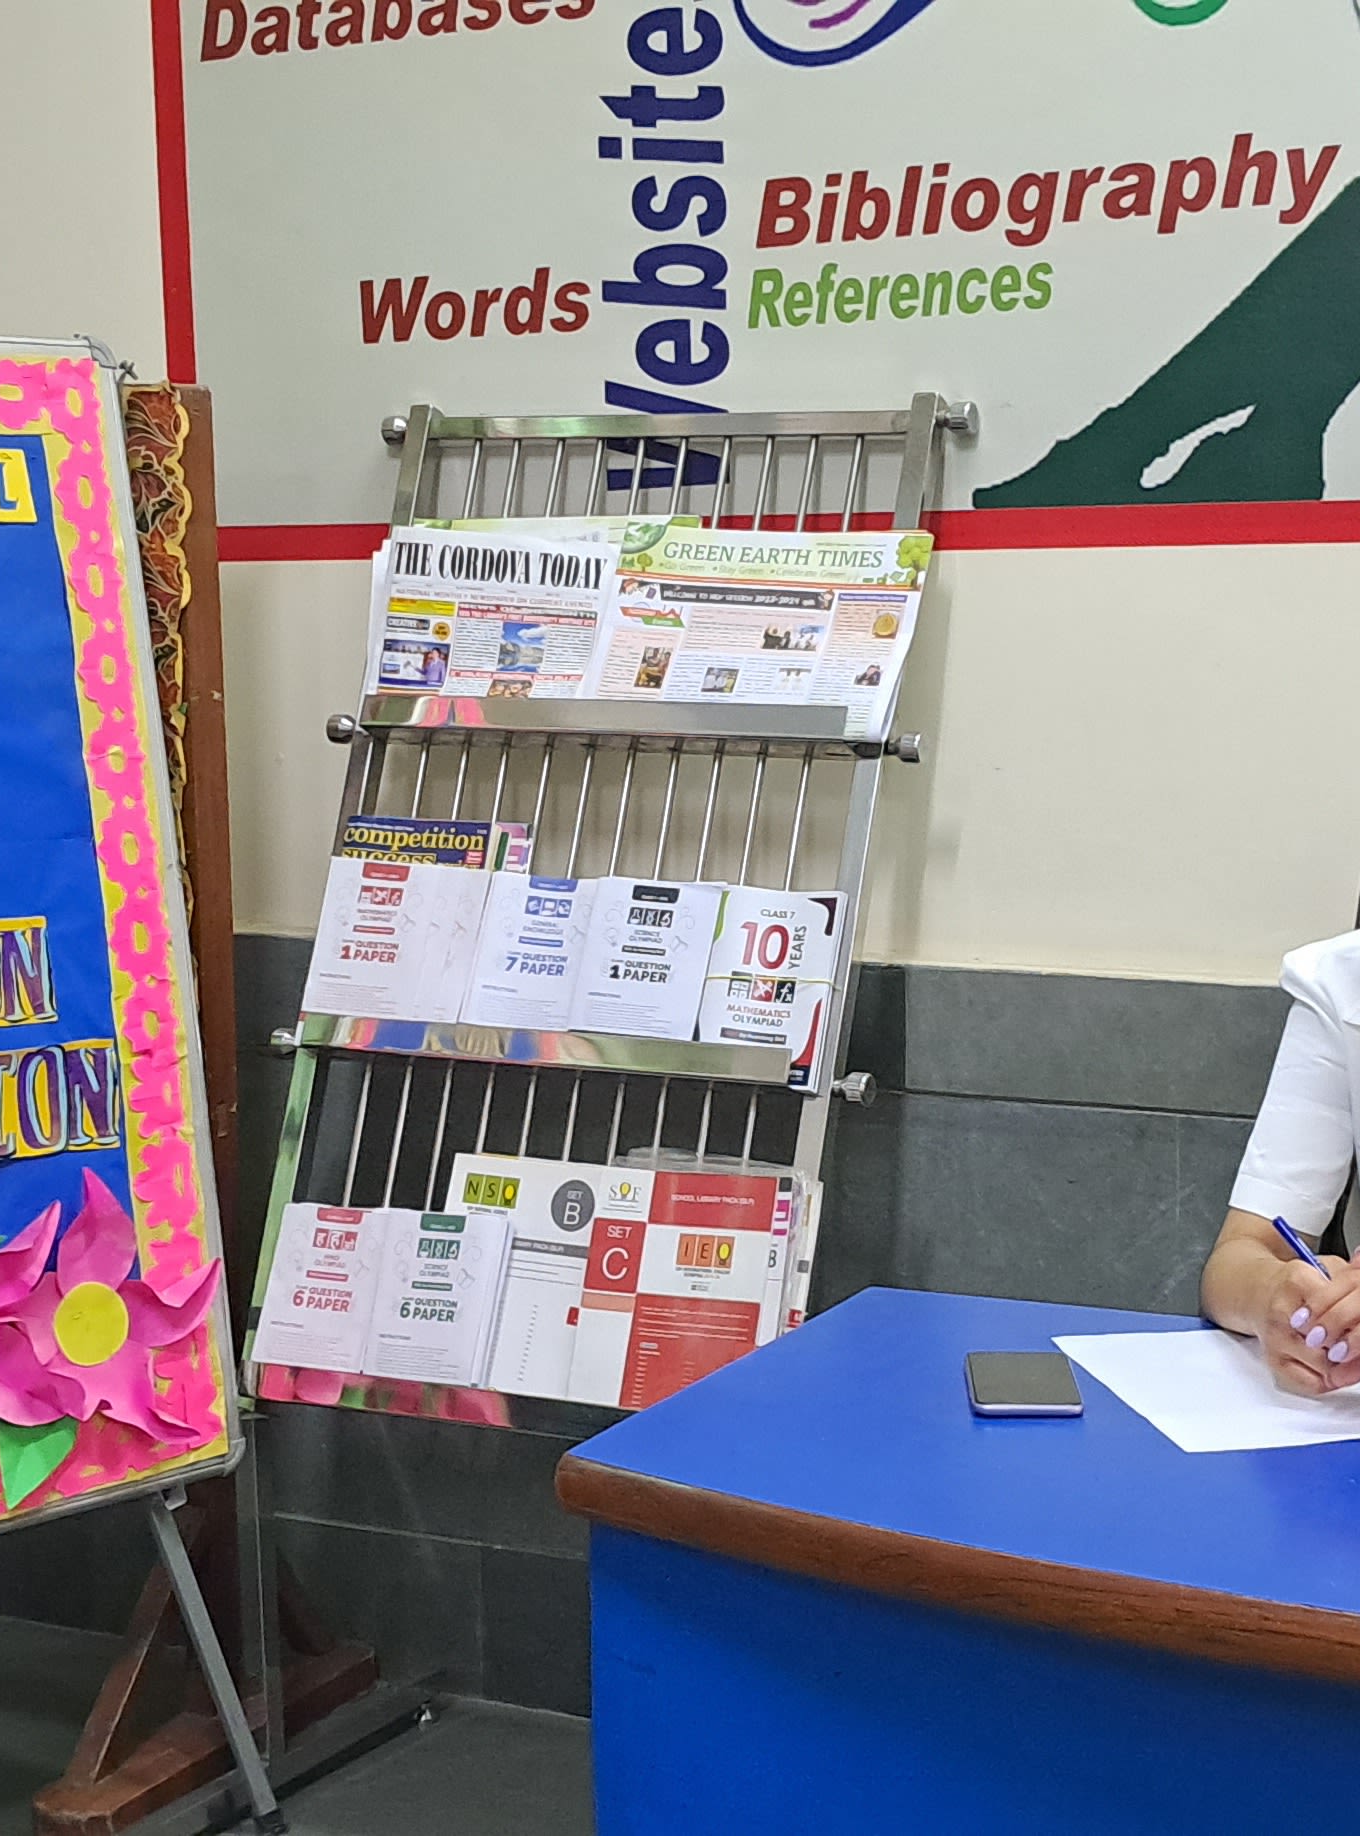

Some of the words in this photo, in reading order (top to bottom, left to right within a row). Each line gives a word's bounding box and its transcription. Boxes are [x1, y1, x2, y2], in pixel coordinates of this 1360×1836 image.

[755, 133, 1342, 249] Bibliography
[748, 258, 1053, 330] References
[359, 267, 591, 344] Words
[663, 541, 736, 562] GREEN
[739, 546, 811, 566] EARTH
[817, 550, 884, 568] TIMES
[394, 542, 433, 577] THE
[440, 544, 531, 585] CORDOVA
[539, 552, 608, 590] TODAY
[343, 826, 484, 852] competition
[342, 848, 436, 866] success
[760, 909, 787, 919] CLASS
[789, 911, 796, 920] 7
[340, 944, 352, 960] 1
[353, 949, 397, 964] PAPER
[354, 940, 400, 951] QUESTION
[741, 921, 790, 970] 10
[788, 925, 808, 970] YEARS
[505, 956, 519, 972] 7
[519, 961, 565, 977] PAPER
[521, 952, 568, 963] QUESTION
[624, 960, 672, 971] QUESTION
[609, 964, 620, 979] 1
[622, 968, 668, 984] PAPER
[726, 1003, 791, 1019] MATHEMATICS
[732, 1015, 784, 1028] OLYMPIAD
[566, 1190, 584, 1200] SET
[563, 1202, 581, 1225] B
[606, 1225, 632, 1239] SET
[602, 1247, 630, 1280] C
[292, 1290, 305, 1307] 6
[306, 1295, 351, 1313] PAPER
[308, 1286, 353, 1299] QUESTION
[400, 1301, 412, 1319] 6
[412, 1307, 456, 1323] PAPER
[414, 1297, 459, 1309] QUESTION
